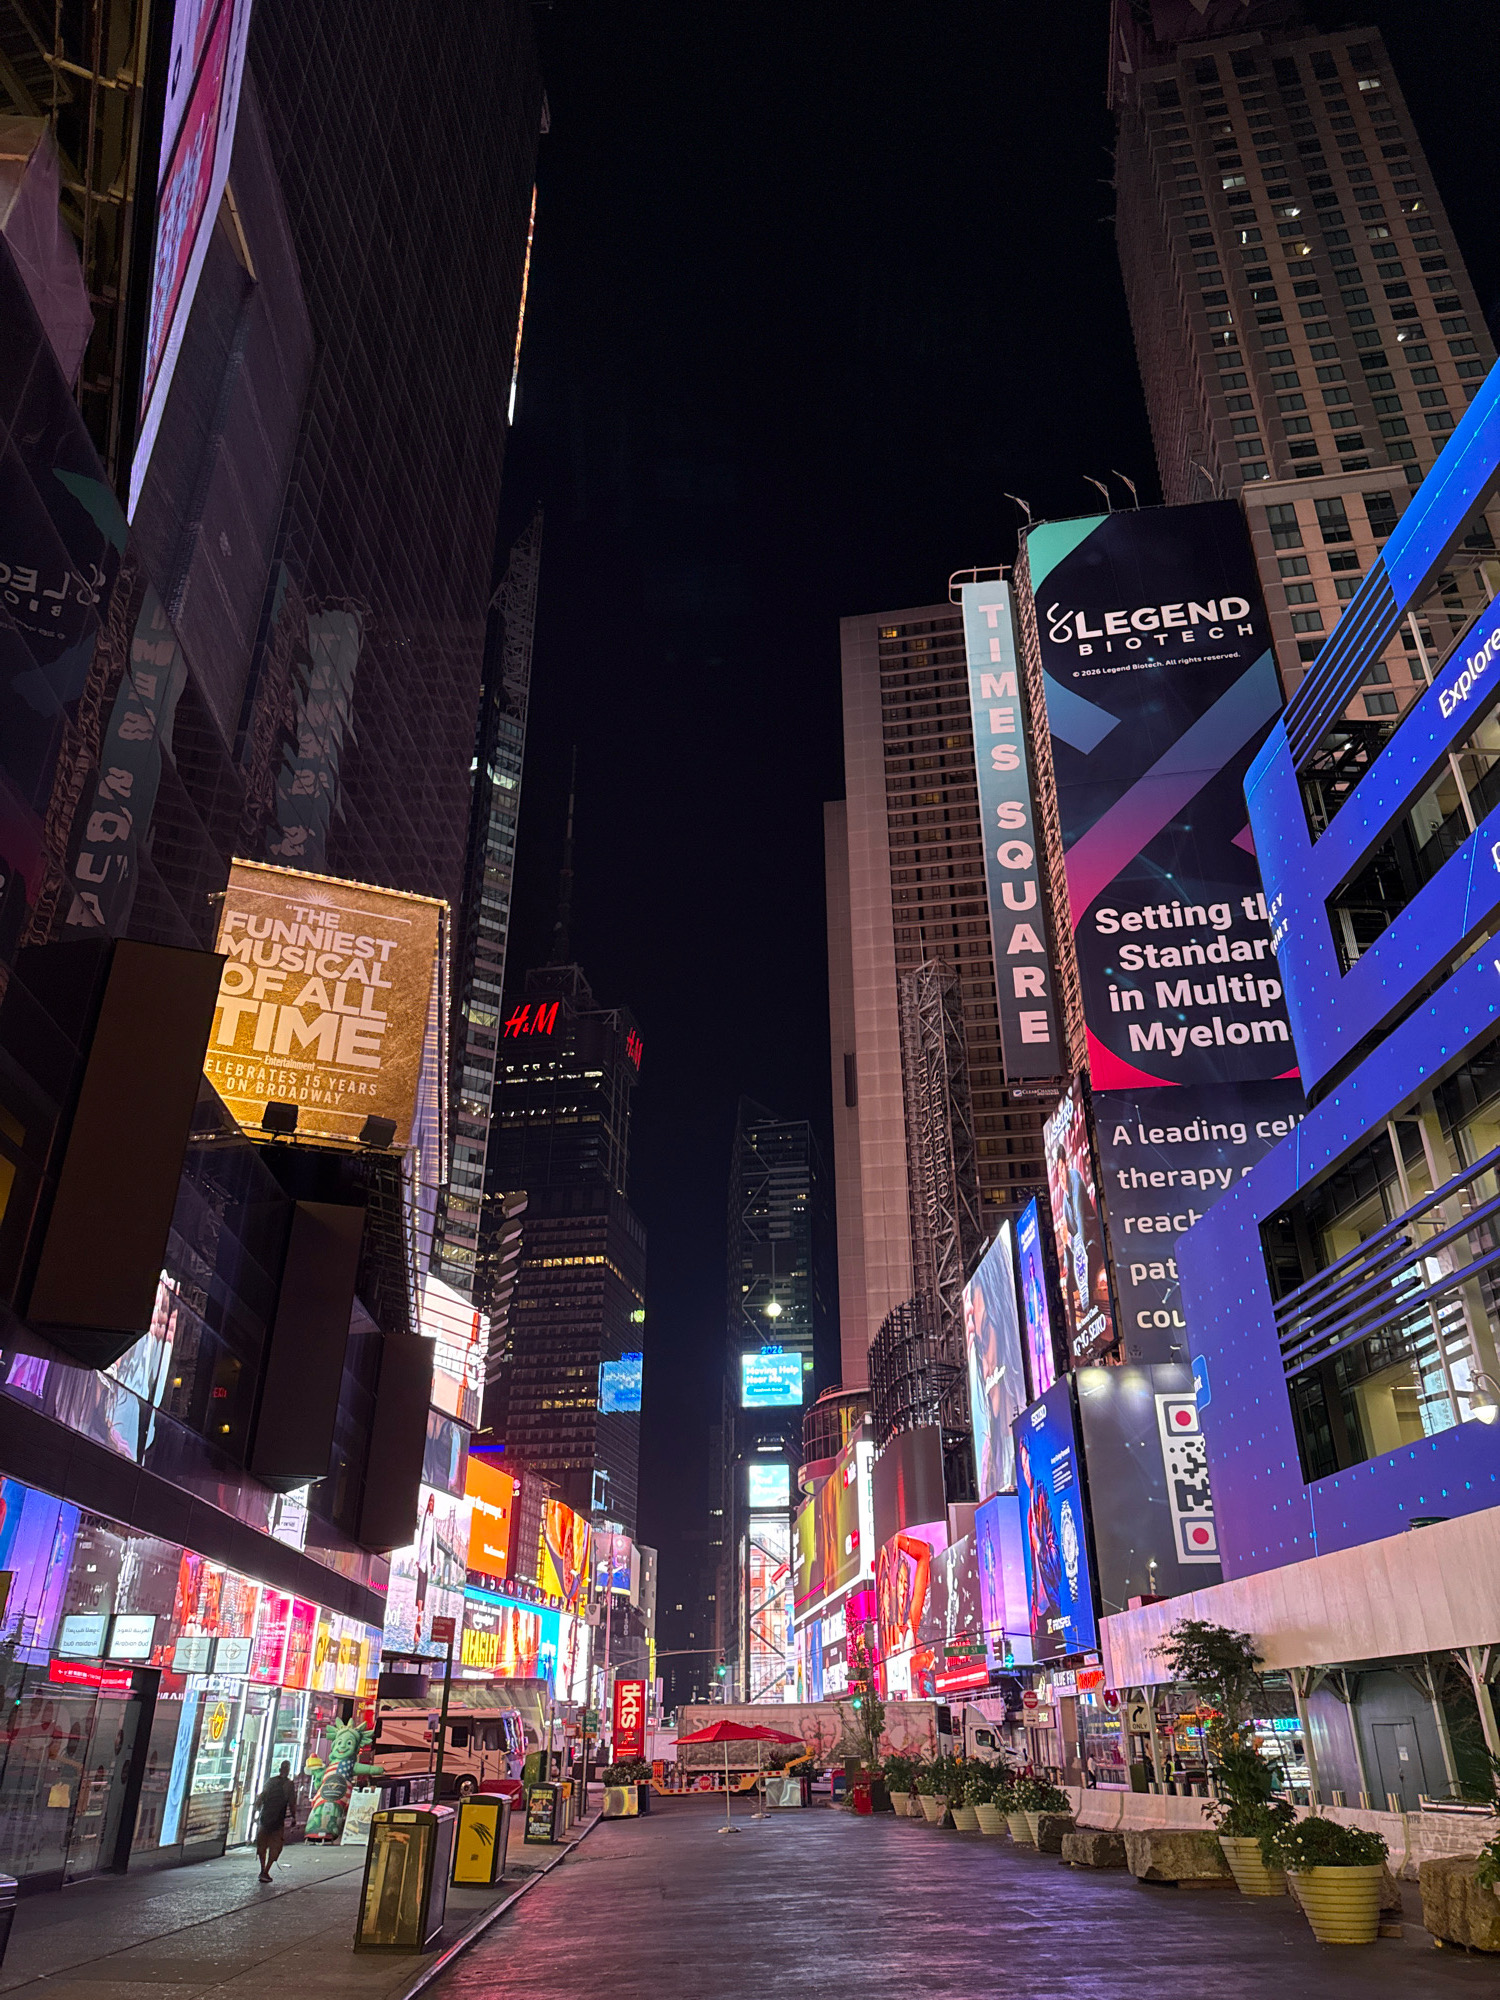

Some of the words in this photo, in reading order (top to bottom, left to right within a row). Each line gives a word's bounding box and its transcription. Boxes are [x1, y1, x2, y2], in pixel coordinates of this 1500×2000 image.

[1077, 597, 1251, 639] LEGEND
[1079, 623, 1254, 656] BIOTECH
[1081, 668, 1101, 677] 2026
[1102, 664, 1131, 675] Legend
[1132, 660, 1165, 671] Biotech.
[1165, 658, 1176, 667] All
[1178, 656, 1202, 667] rights
[1203, 652, 1241, 663] reserved.
[1438, 628, 1500, 719] Explore
[978, 604, 1021, 771] TIMES
[997, 802, 1050, 1044] SQUARE
[1095, 900, 1233, 935] Setting
[224, 911, 398, 962] FUNNIEST
[218, 935, 393, 989] MUSICAL
[220, 962, 287, 999] OF
[292, 977, 388, 1021] ALL
[1108, 984, 1144, 1013] in
[1155, 973, 1282, 1009] Multip
[504, 1001, 560, 1038] H&M
[1128, 1016, 1293, 1057] Myelom
[263, 1055, 316, 1072] Entertainment
[626, 1027, 643, 1072] H&M
[226, 1077, 248, 1093] ON
[255, 1081, 345, 1106] BROADWAY
[305, 1073, 321, 1088] 15
[329, 1077, 378, 1097] YEARS
[1112, 1125, 1132, 1147] A
[1138, 1119, 1248, 1145] leading
[1117, 1166, 1233, 1191] therapy
[1130, 1257, 1178, 1285] pat
[1088, 1313, 1106, 1342] SEIKO
[761, 1345, 784, 1355] 2026
[746, 1366, 777, 1378] Moving
[779, 1365, 799, 1376] Help
[769, 1375, 783, 1384] Me
[620, 1683, 641, 1729] tkts
